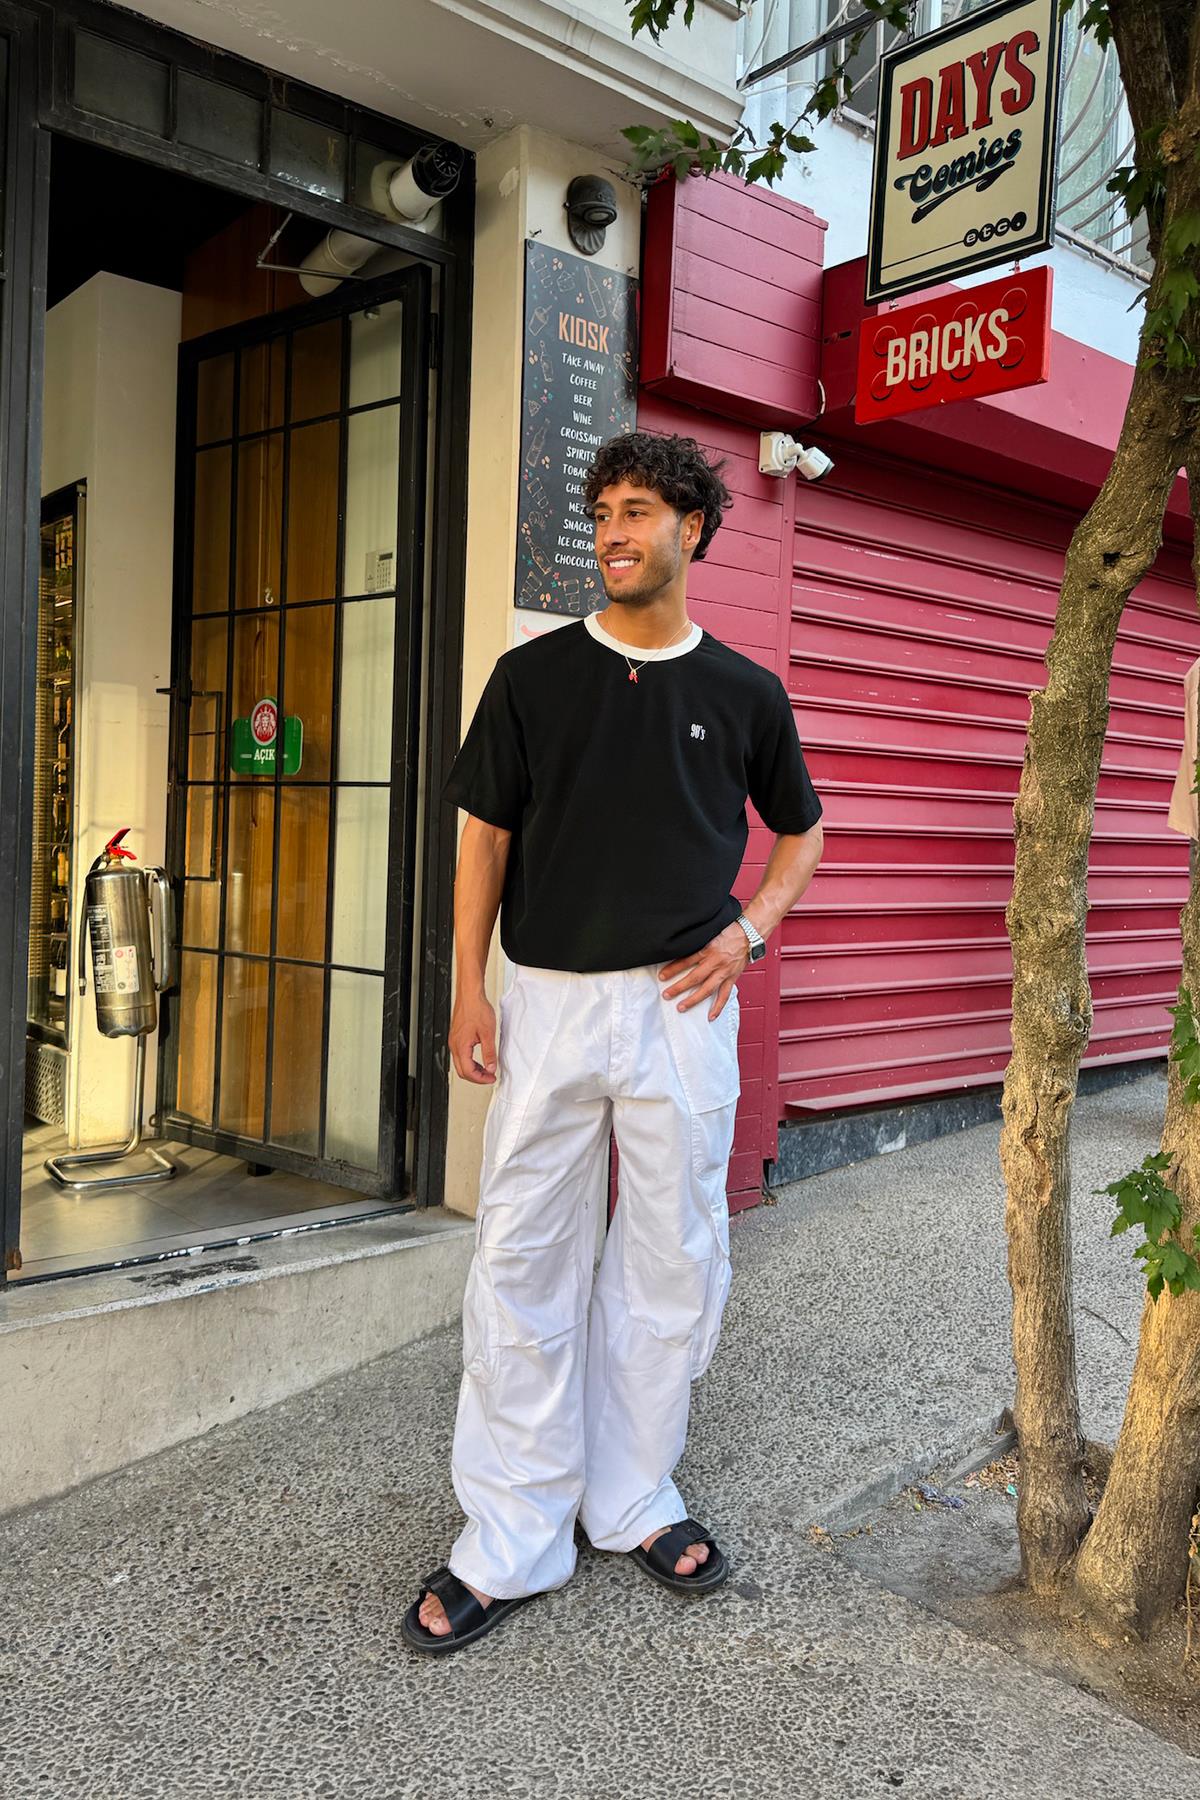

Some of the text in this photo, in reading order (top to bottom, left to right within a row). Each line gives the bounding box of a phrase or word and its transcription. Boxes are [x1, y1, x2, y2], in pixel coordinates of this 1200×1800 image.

[897, 30, 1040, 161] DAYS
[894, 128, 1023, 203] Comics
[965, 216, 1024, 245] etc.
[559, 312, 609, 355] KIOSK
[886, 308, 1009, 387] BRICKS
[562, 352, 605, 376] TAKE AWAY
[570, 373, 597, 390] COFFEE
[573, 394, 592, 407] BEER
[572, 410, 592, 425] WINE
[560, 427, 603, 446] CROISSANT
[566, 446, 596, 463] SPIRITS
[562, 463, 588, 478] TOBAC
[568, 502, 585, 515] MEZ
[563, 518, 594, 535] SNACKS
[557, 535, 570, 547] ICE
[554, 553, 598, 570] CHOCOLATE
[253, 748, 275, 765] AÇIK
